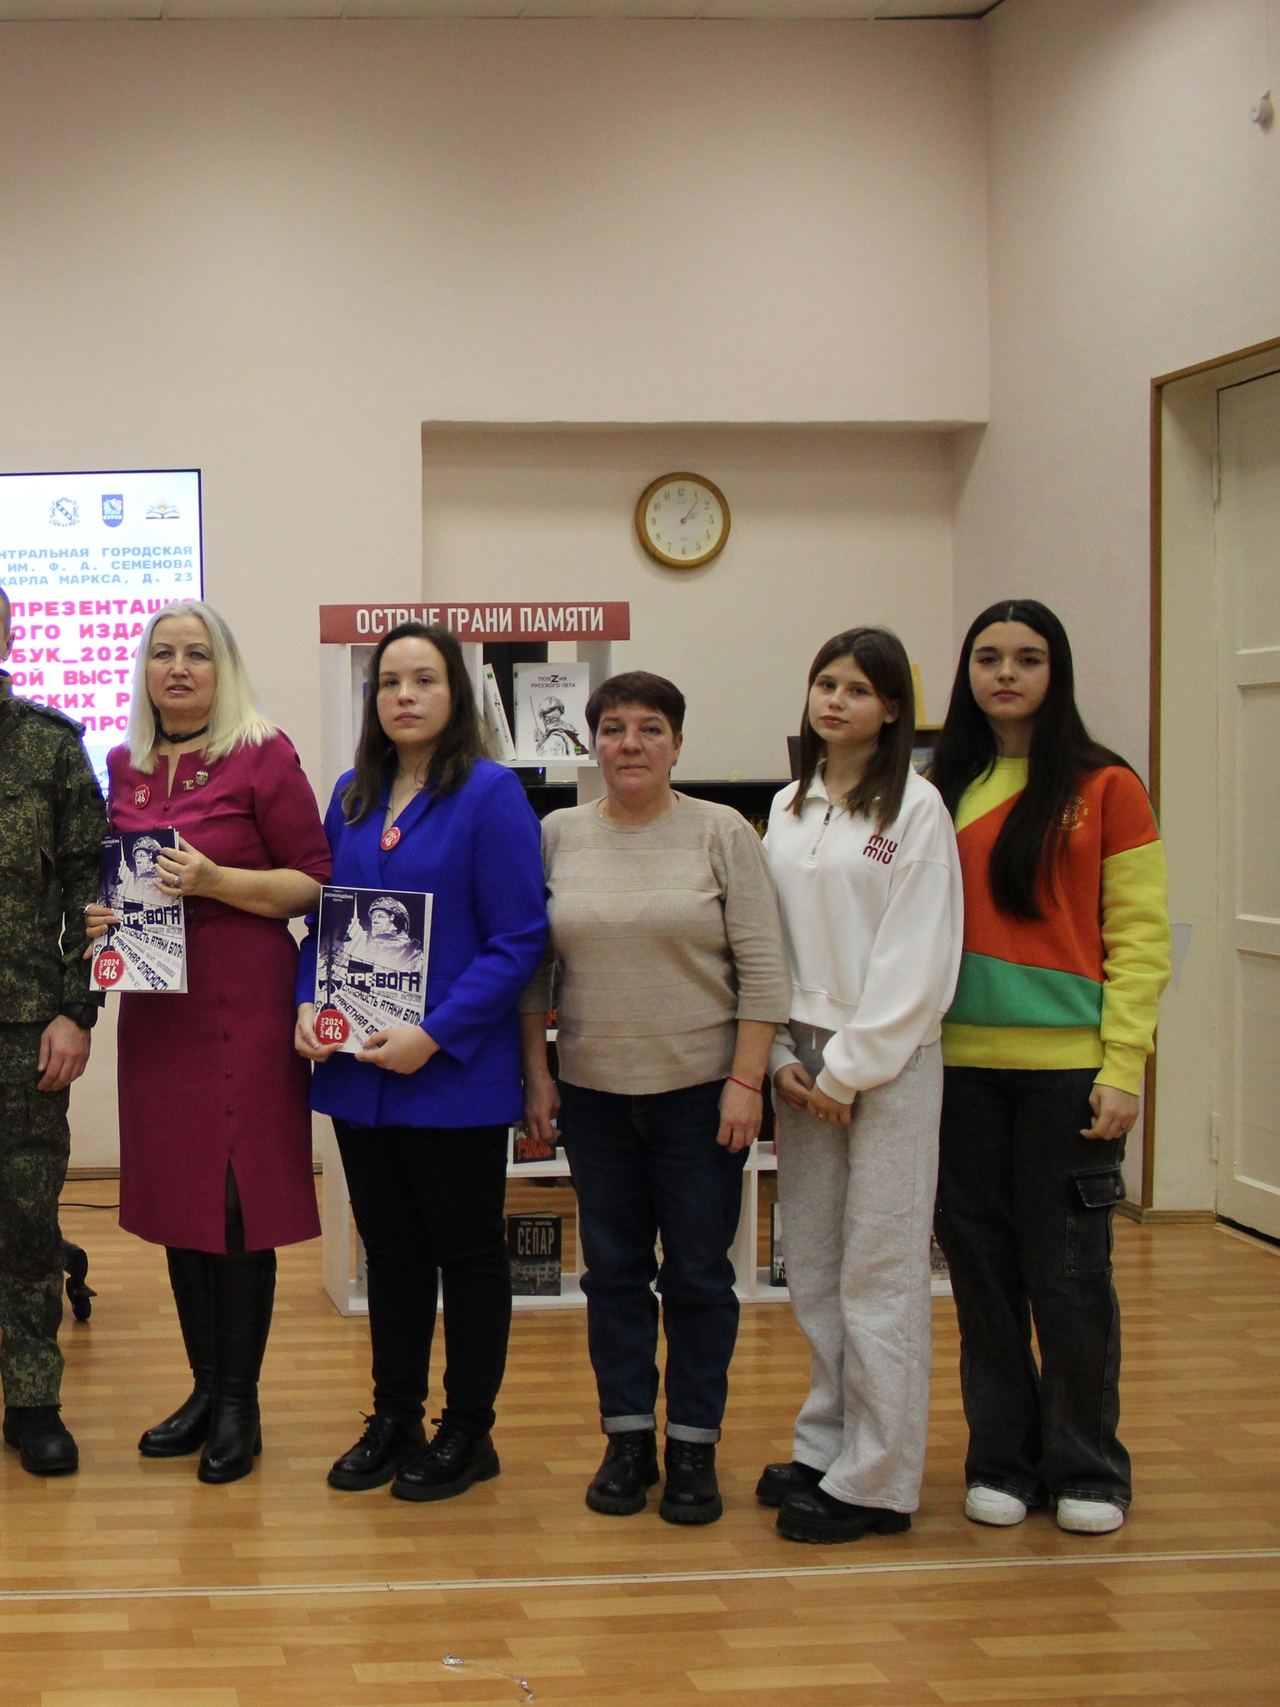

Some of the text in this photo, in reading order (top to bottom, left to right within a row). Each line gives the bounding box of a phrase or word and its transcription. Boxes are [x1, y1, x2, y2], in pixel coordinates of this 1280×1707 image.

[101, 545, 193, 557] ГОРОДСКАЯ
[7, 563, 35, 572] ИМ.
[49, 562, 66, 571] Ф.
[80, 561, 97, 571] А.
[111, 559, 193, 570] СЕМЕНОВА
[59, 573, 129, 585] МАРКСА,
[142, 573, 160, 584] Д.
[174, 572, 193, 582] 23
[447, 607, 513, 633] ГРАНИ
[519, 606, 604, 632] ПАМЯТИ
[79, 622, 144, 641] ИЗДА
[123, 904, 181, 925] ТРЕВОГА
[103, 958, 120, 967] 2024
[102, 966, 118, 980] 46
[346, 971, 420, 993] ТРЕВОГА
[334, 993, 369, 1028] РАКЕТНАЯ
[379, 999, 404, 1019] АТАКИ
[324, 1017, 344, 1027] 2024
[324, 1026, 343, 1041] 46
[517, 1227, 555, 1255] СЕПАР
